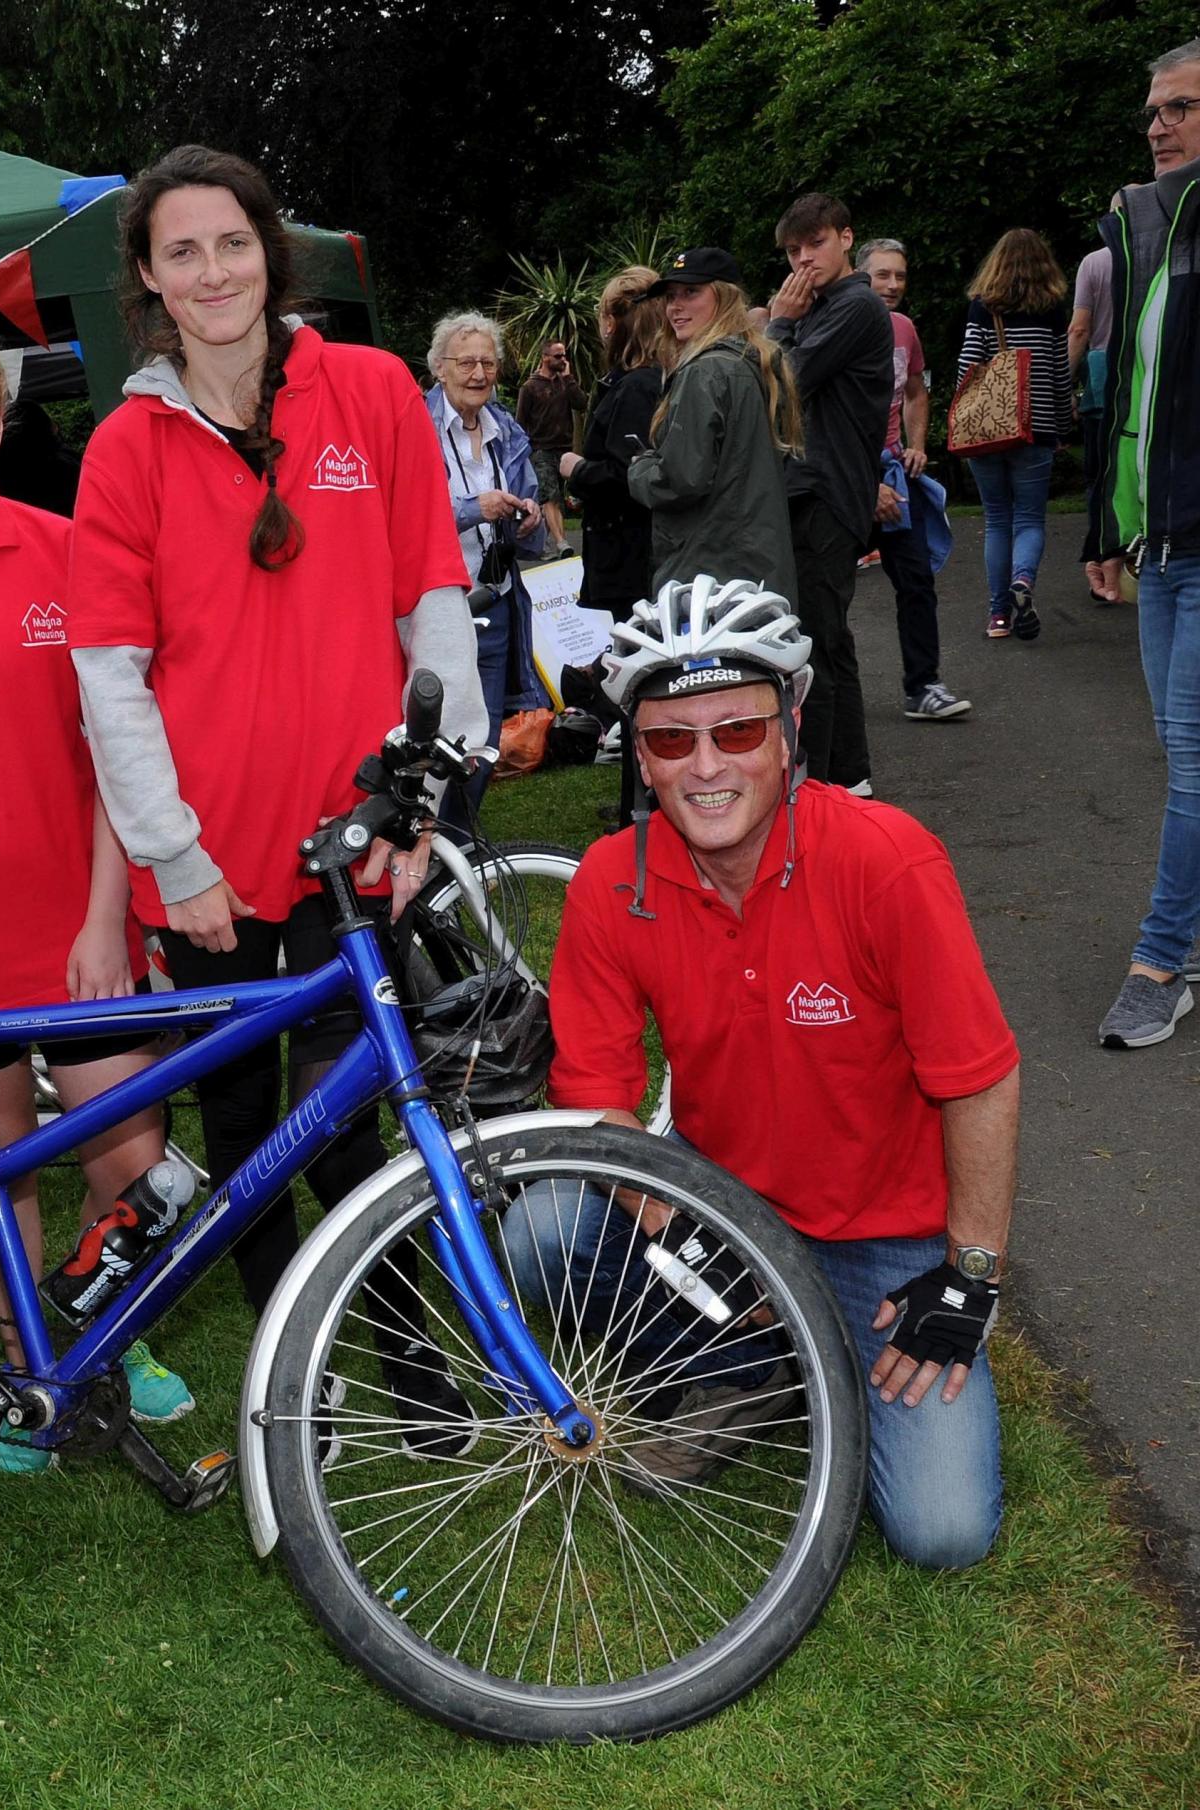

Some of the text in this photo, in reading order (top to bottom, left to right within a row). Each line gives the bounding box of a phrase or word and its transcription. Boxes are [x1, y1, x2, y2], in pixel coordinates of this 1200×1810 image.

[325, 459, 357, 475] Magna
[325, 473, 359, 487] Housing
[532, 592, 580, 613] TOMBOLA
[32, 617, 62, 630] Magna
[34, 630, 66, 641] Housing
[798, 996, 836, 1010] Magna
[798, 1010, 840, 1021] Housing
[71, 1265, 115, 1311] Discovery
